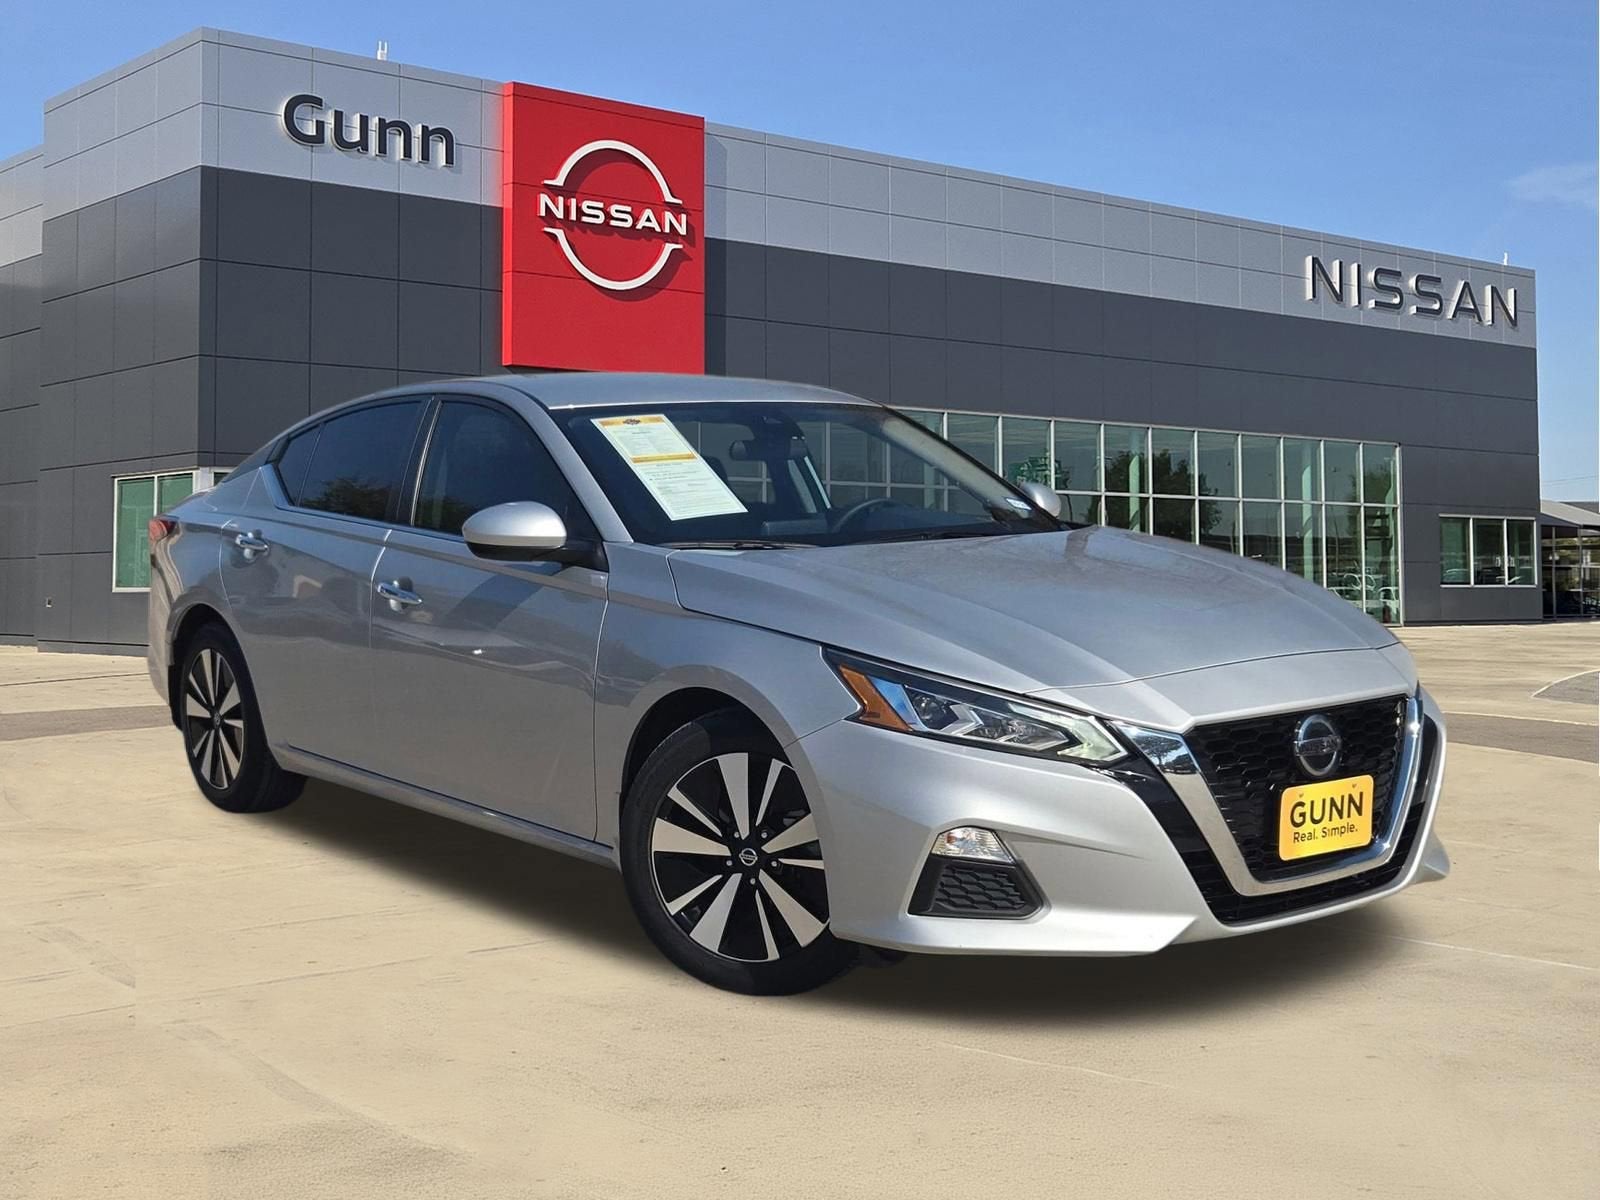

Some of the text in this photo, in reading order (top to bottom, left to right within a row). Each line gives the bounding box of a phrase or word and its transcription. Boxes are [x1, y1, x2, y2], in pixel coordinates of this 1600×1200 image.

[282, 94, 456, 168] Gunn
[538, 193, 688, 236] NISSAN
[1305, 255, 1518, 328] NISSAN
[1290, 791, 1364, 828] GUNN
[1293, 822, 1358, 843] Real. Simple.
